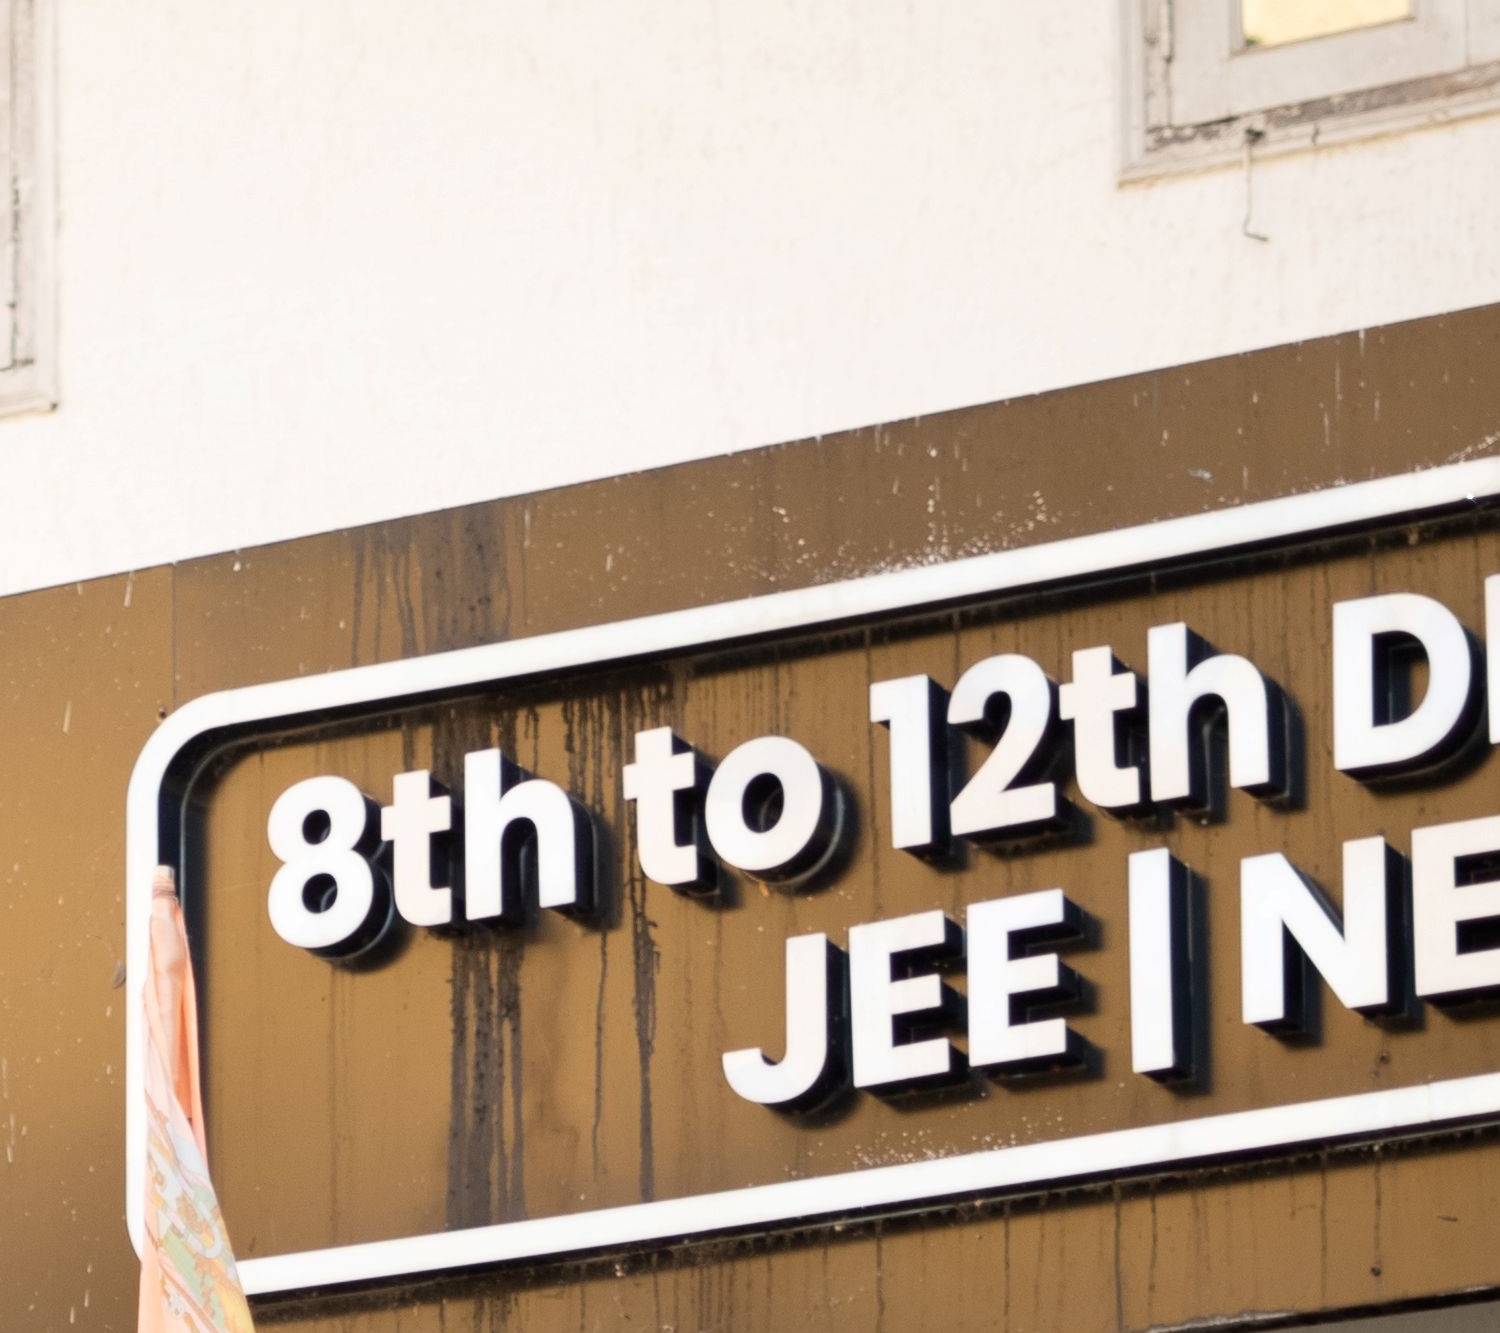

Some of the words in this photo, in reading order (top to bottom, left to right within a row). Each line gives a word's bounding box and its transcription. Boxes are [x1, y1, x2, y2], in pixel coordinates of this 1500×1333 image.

[266, 745, 580, 951] 8th
[622, 725, 826, 889] to
[868, 620, 1276, 852] 12th
[720, 886, 1070, 1108] JEE
